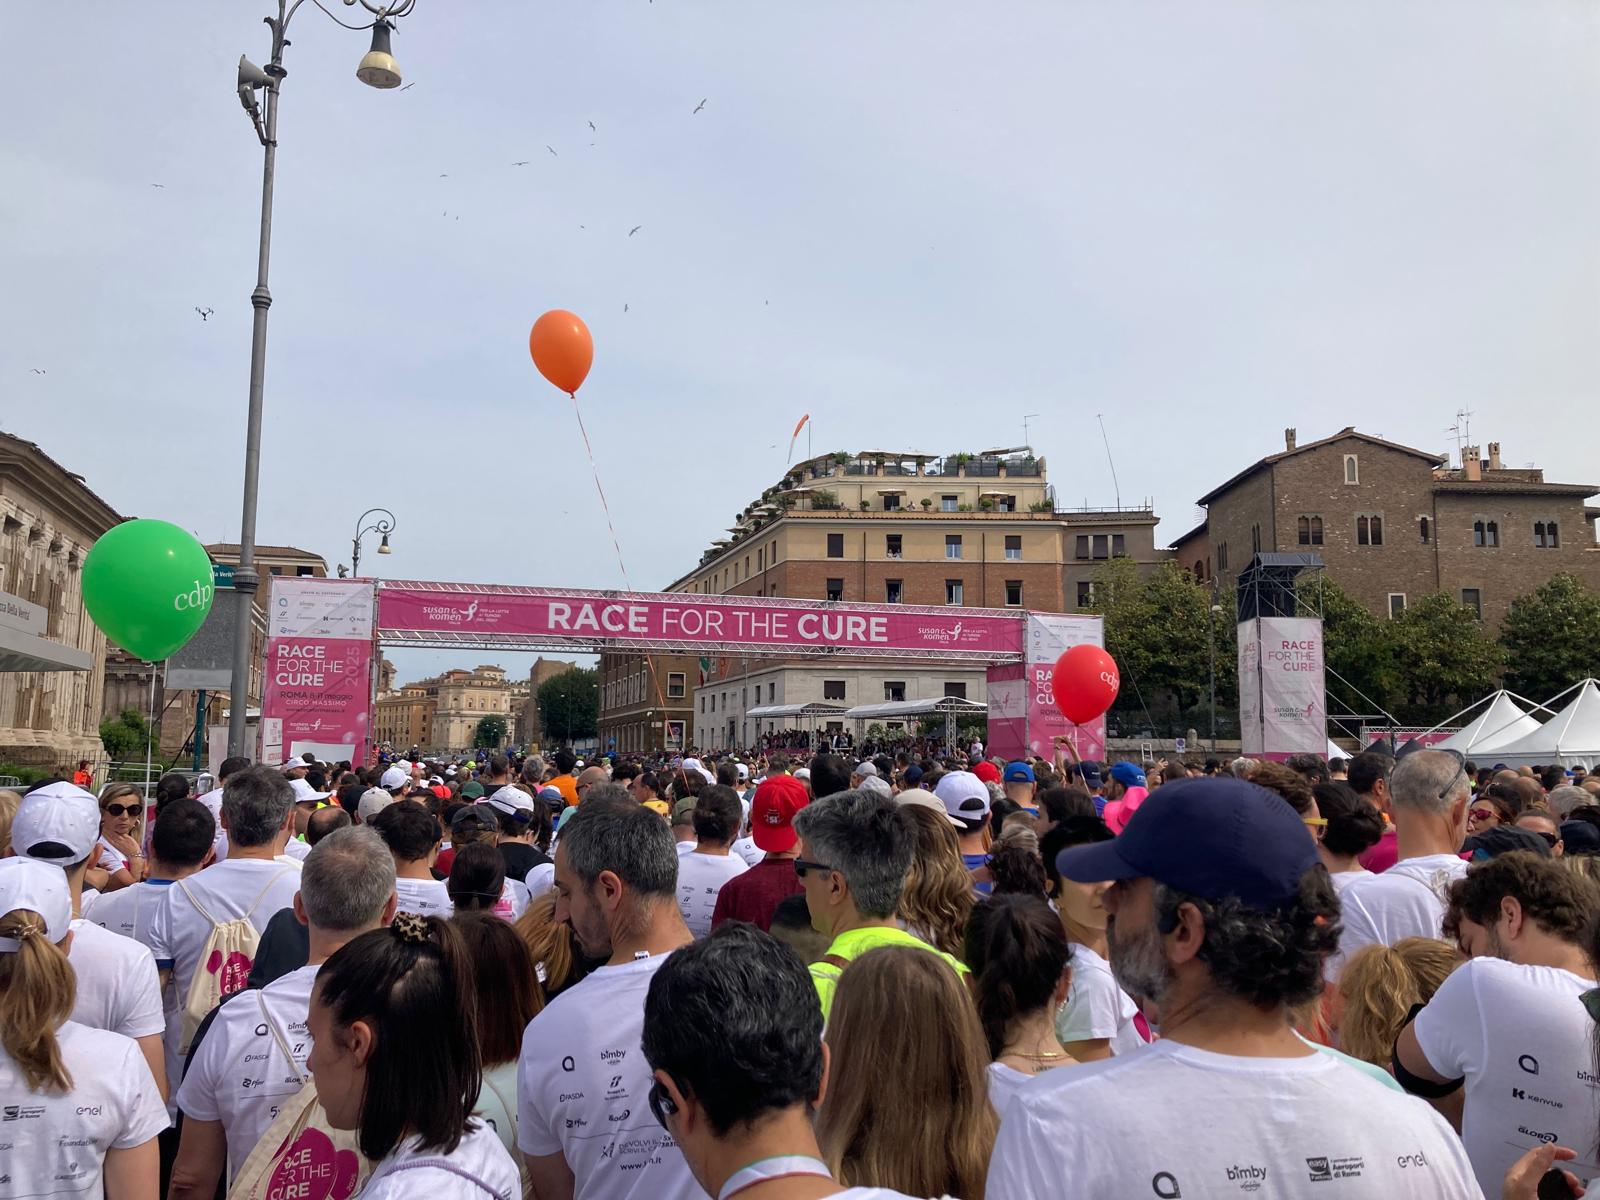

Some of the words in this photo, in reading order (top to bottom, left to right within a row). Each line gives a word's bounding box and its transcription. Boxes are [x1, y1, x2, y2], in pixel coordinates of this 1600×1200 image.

[174, 579, 212, 611] cdp
[423, 606, 450, 615] susan
[429, 613, 462, 622] komen
[547, 602, 649, 633] RACE
[662, 608, 724, 636] FOR
[732, 611, 789, 638] THE
[797, 613, 889, 642] CURE
[277, 644, 326, 659] RACE
[1282, 640, 1316, 651] RACE
[1267, 651, 1292, 661] FOR
[1294, 651, 1316, 661] THE
[276, 659, 310, 673] FOR
[312, 660, 344, 674] THE
[344, 646, 360, 688] 2025
[1283, 662, 1316, 672] CURE
[275, 672, 325, 687] CURE
[1036, 670, 1054, 682] RA
[1100, 671, 1119, 692] cdp
[1036, 681, 1054, 693] FO
[279, 691, 308, 700] ROMA
[1036, 693, 1057, 705] CU
[284, 699, 310, 707] CIRCO
[312, 699, 348, 707] MASSIMO
[600, 1050, 626, 1060] bimby
[76, 1105, 102, 1116] enel
[1397, 1150, 1428, 1168] enel
[299, 1162, 331, 1180] THE
[1332, 1161, 1364, 1171] Aeroporti
[1226, 1164, 1267, 1181] bimby
